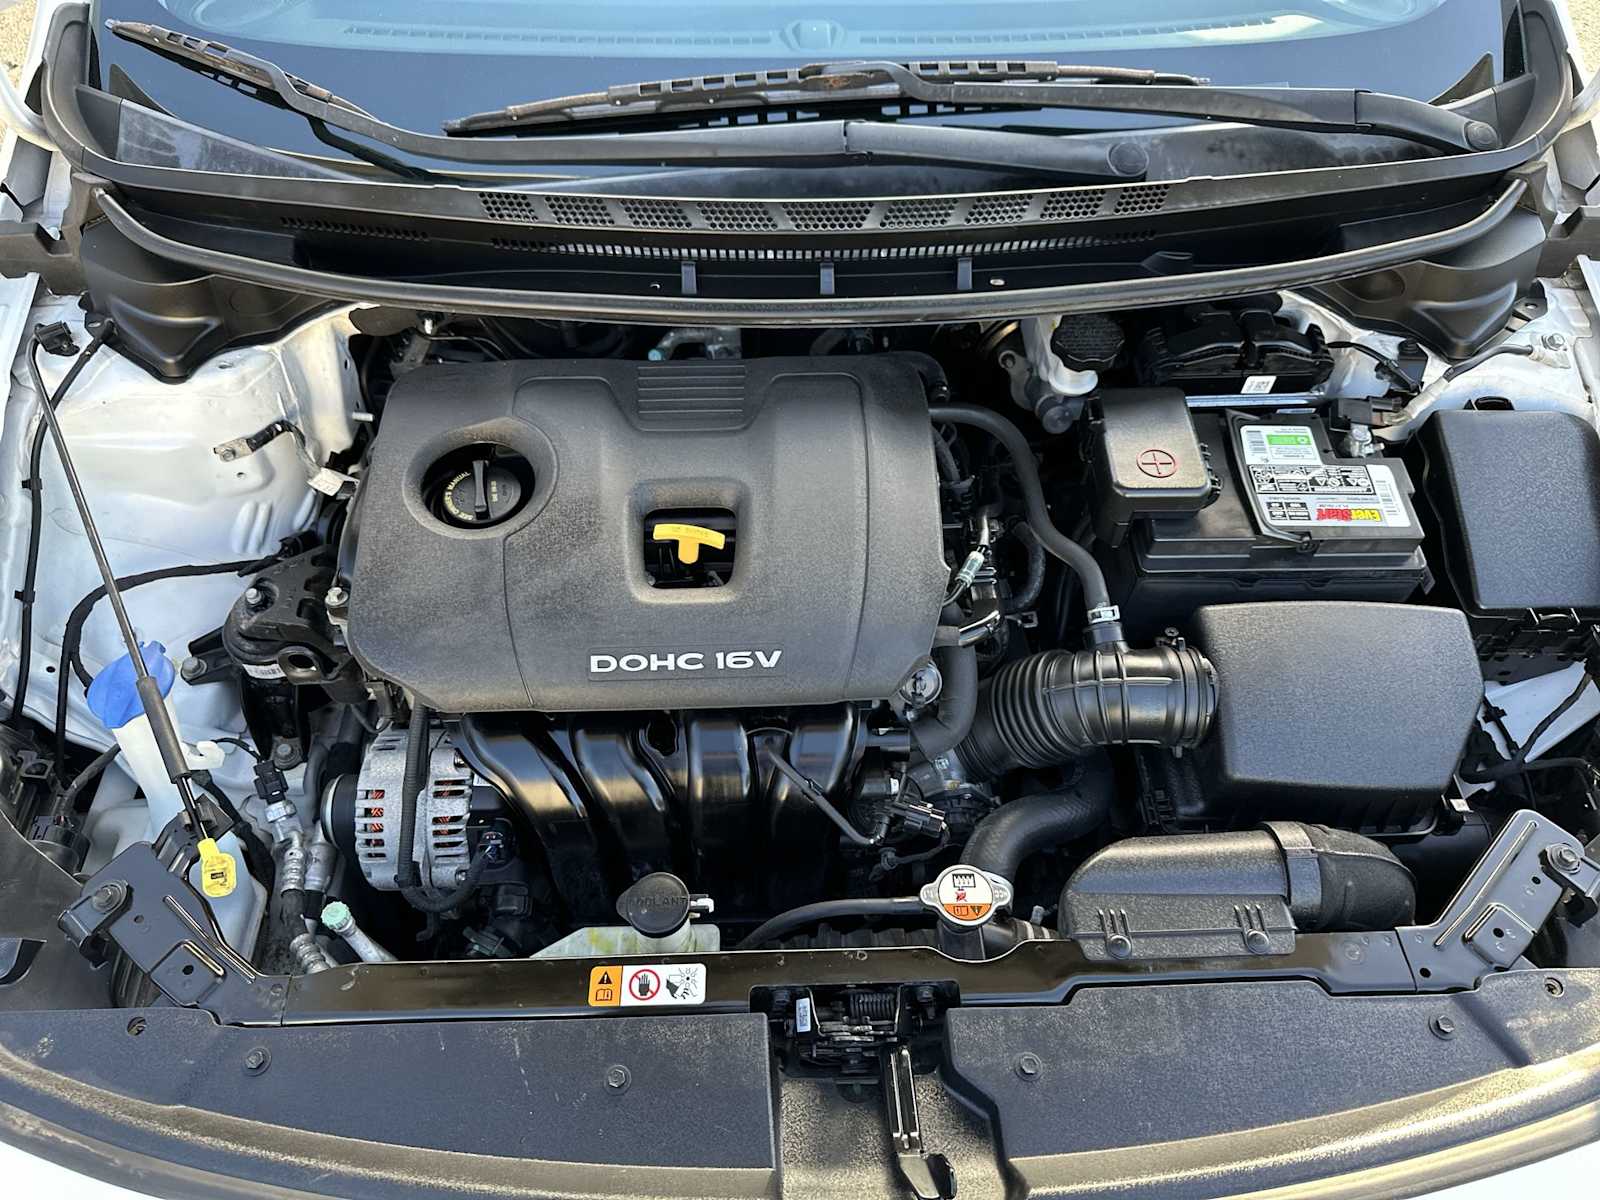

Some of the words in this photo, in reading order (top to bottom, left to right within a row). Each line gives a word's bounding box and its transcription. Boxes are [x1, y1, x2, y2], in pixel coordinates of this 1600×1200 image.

[447, 471, 472, 491] MANUAL
[590, 652, 704, 673] DOHC
[716, 650, 783, 670] 16V
